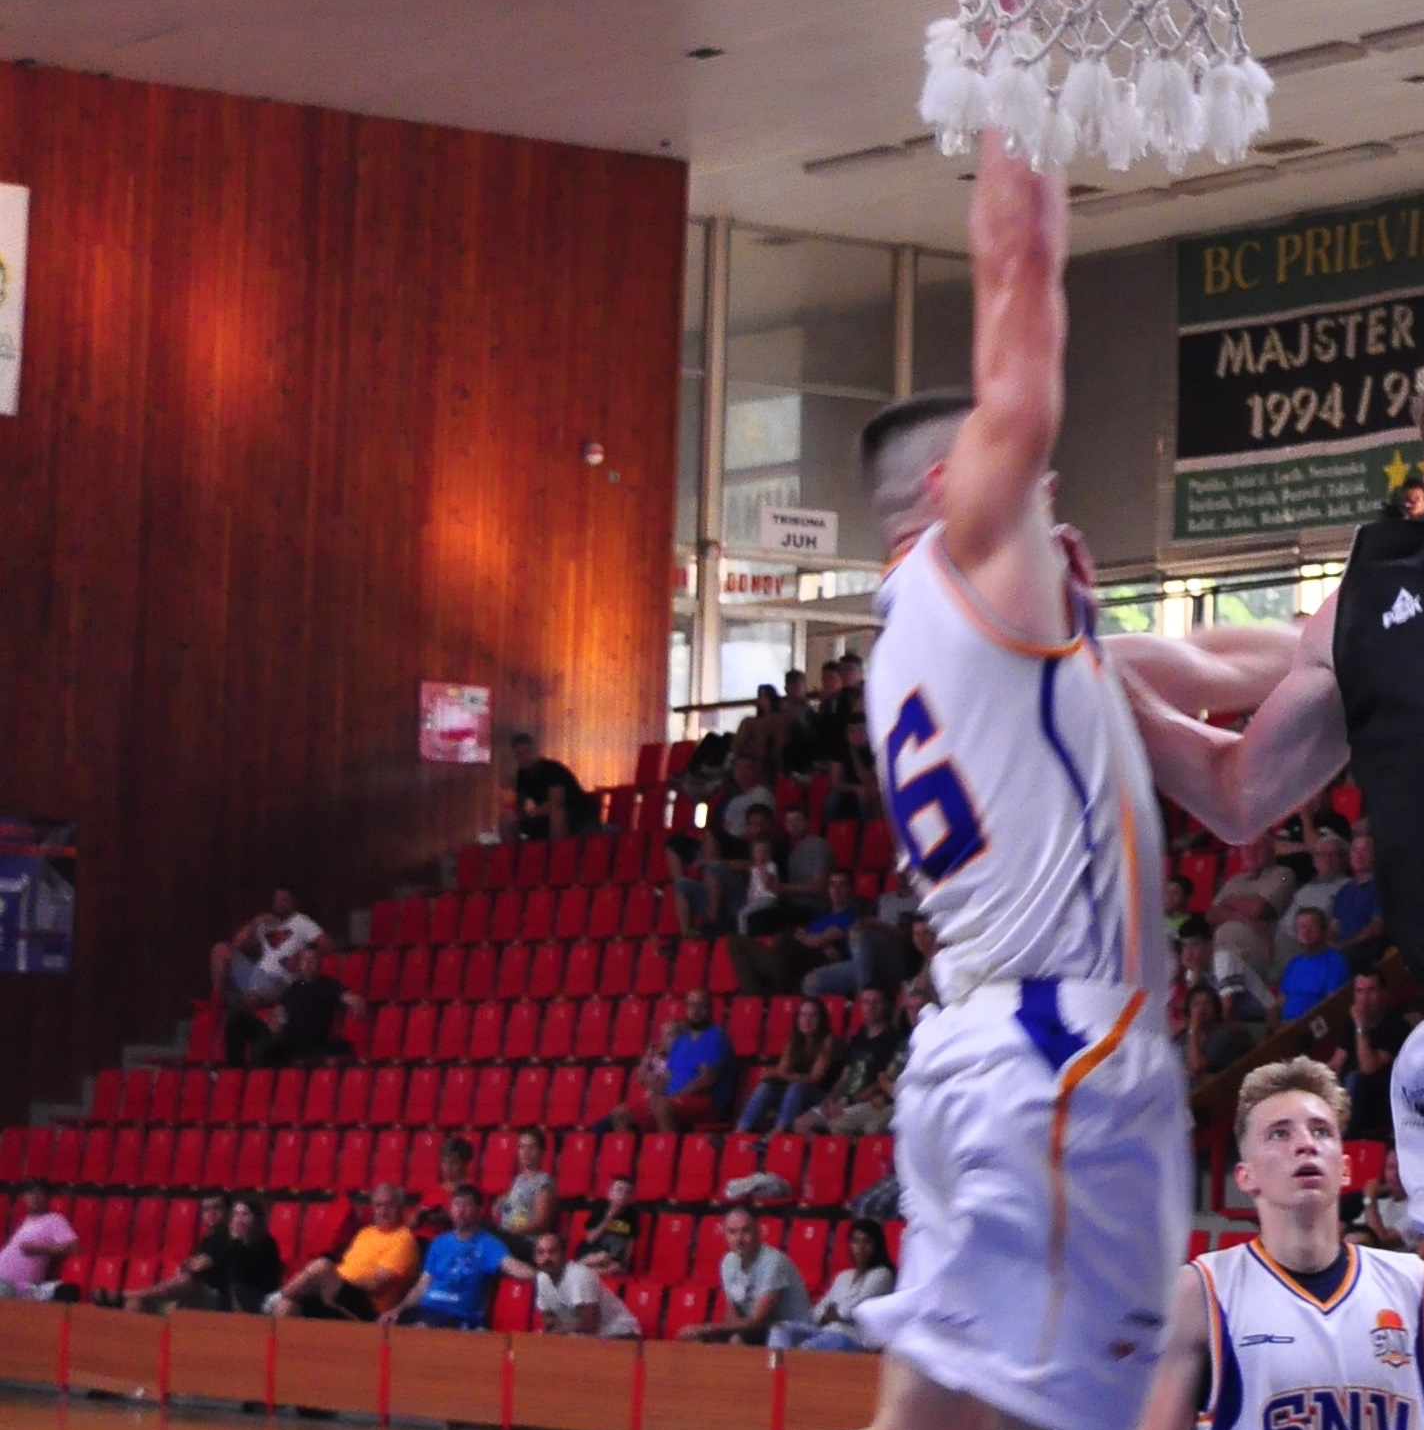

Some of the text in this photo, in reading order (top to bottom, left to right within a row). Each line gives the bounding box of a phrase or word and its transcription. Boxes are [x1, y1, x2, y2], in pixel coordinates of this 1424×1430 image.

[1203, 242, 1261, 295] BC
[1215, 305, 1416, 379] MAJSTER
[1246, 371, 1412, 439] 1994/9
[782, 533, 817, 548] JUH
[887, 687, 989, 881] 6
